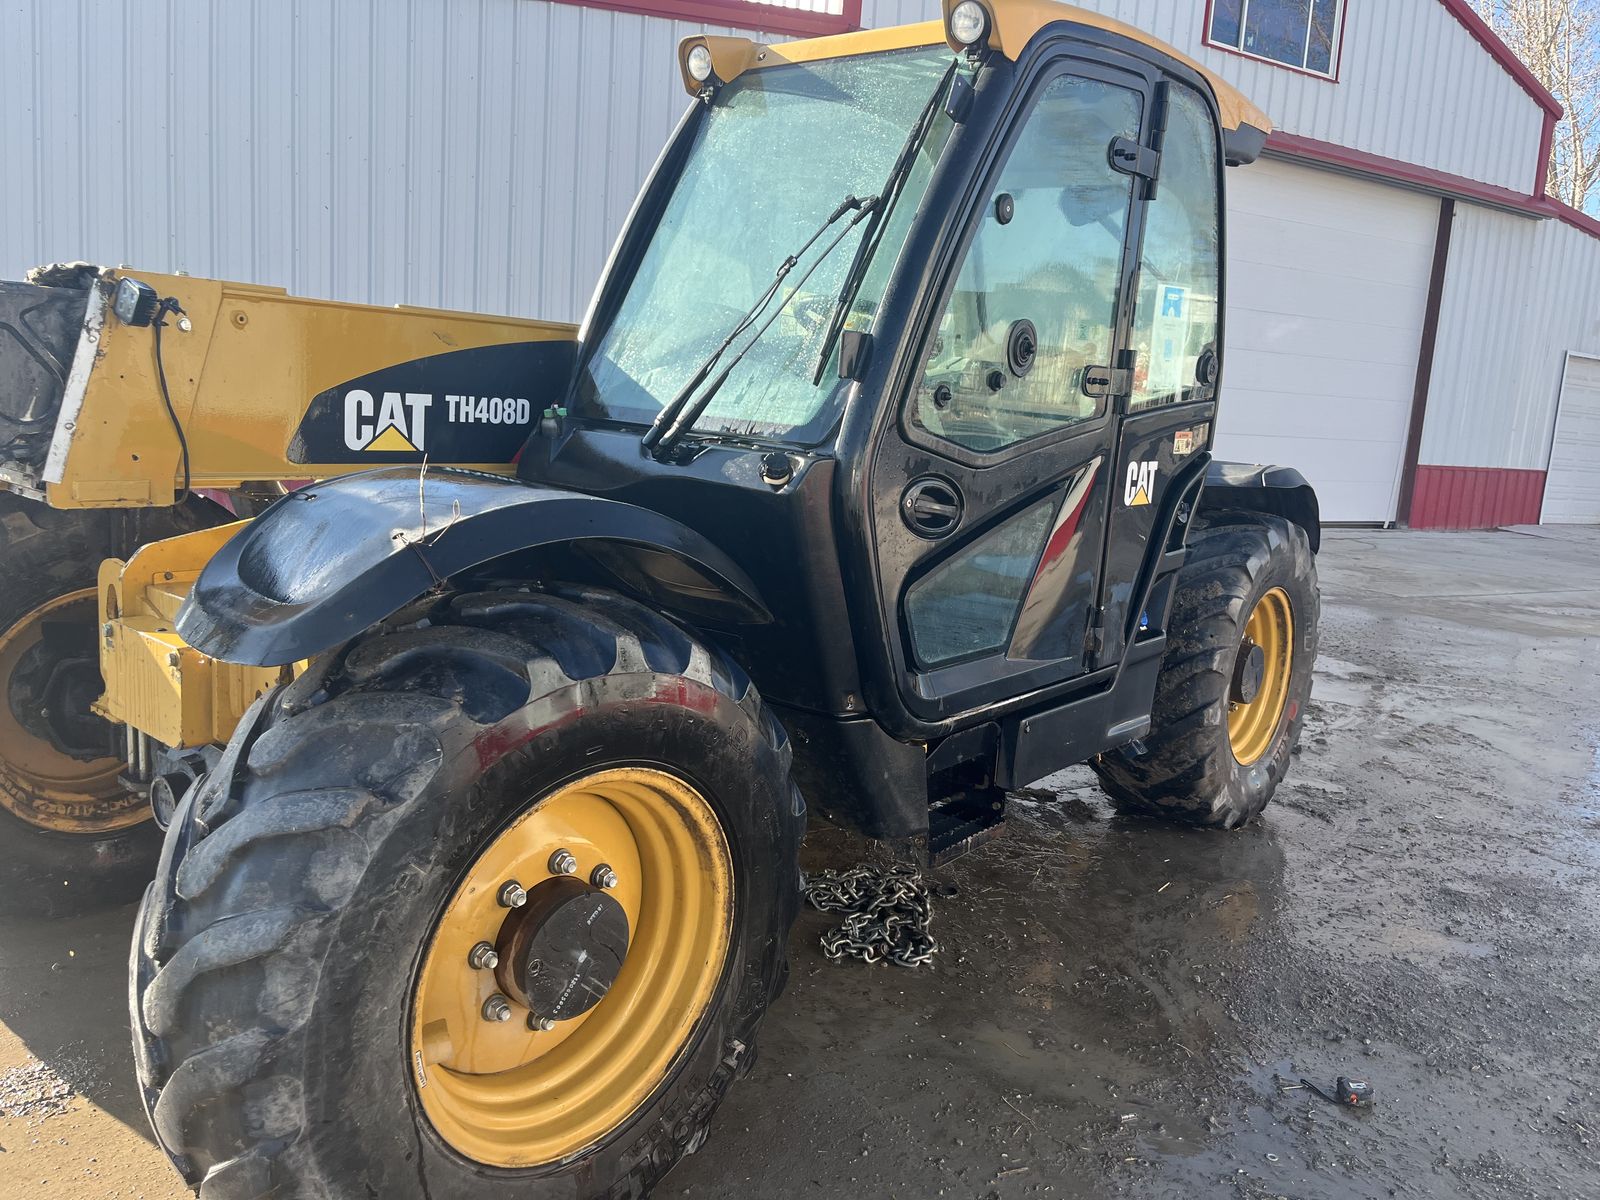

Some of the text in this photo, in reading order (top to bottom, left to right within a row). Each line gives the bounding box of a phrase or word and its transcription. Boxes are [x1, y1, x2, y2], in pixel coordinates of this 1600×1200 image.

[344, 389, 530, 450] CAT TH408D
[1124, 461, 1159, 506] CAT
